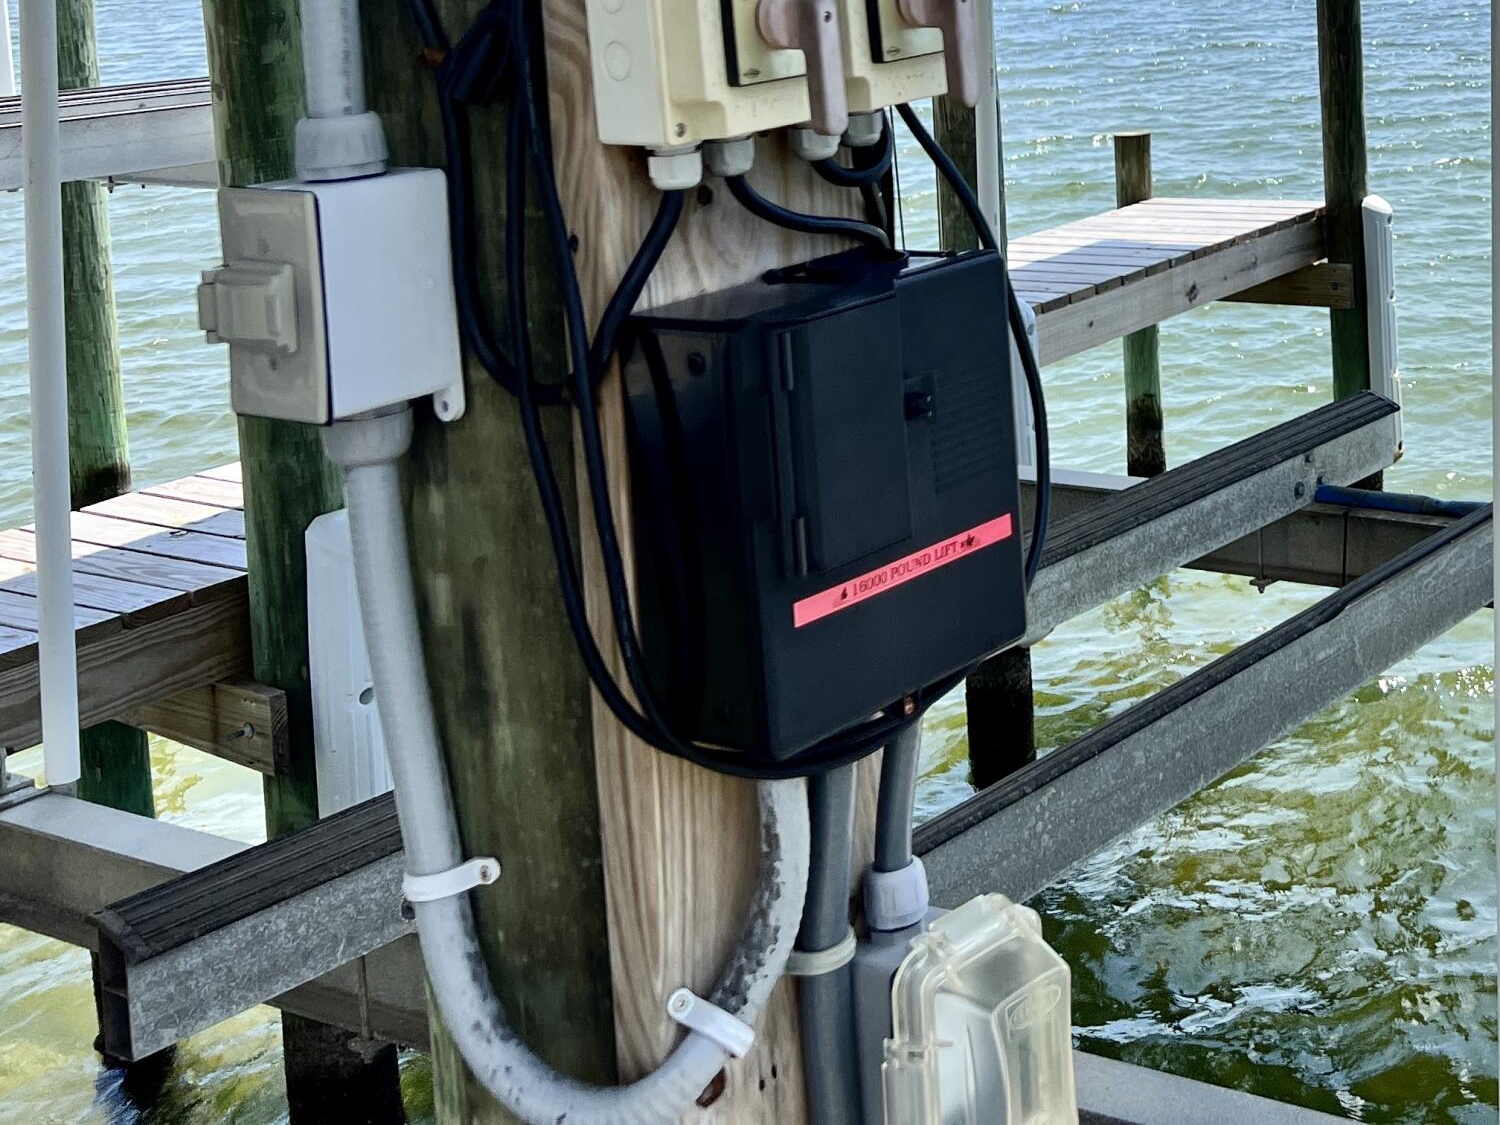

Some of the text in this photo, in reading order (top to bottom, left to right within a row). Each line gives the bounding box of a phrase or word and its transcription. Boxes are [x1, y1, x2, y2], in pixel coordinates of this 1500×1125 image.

[853, 541, 958, 596] 16000 POUND LIFT
